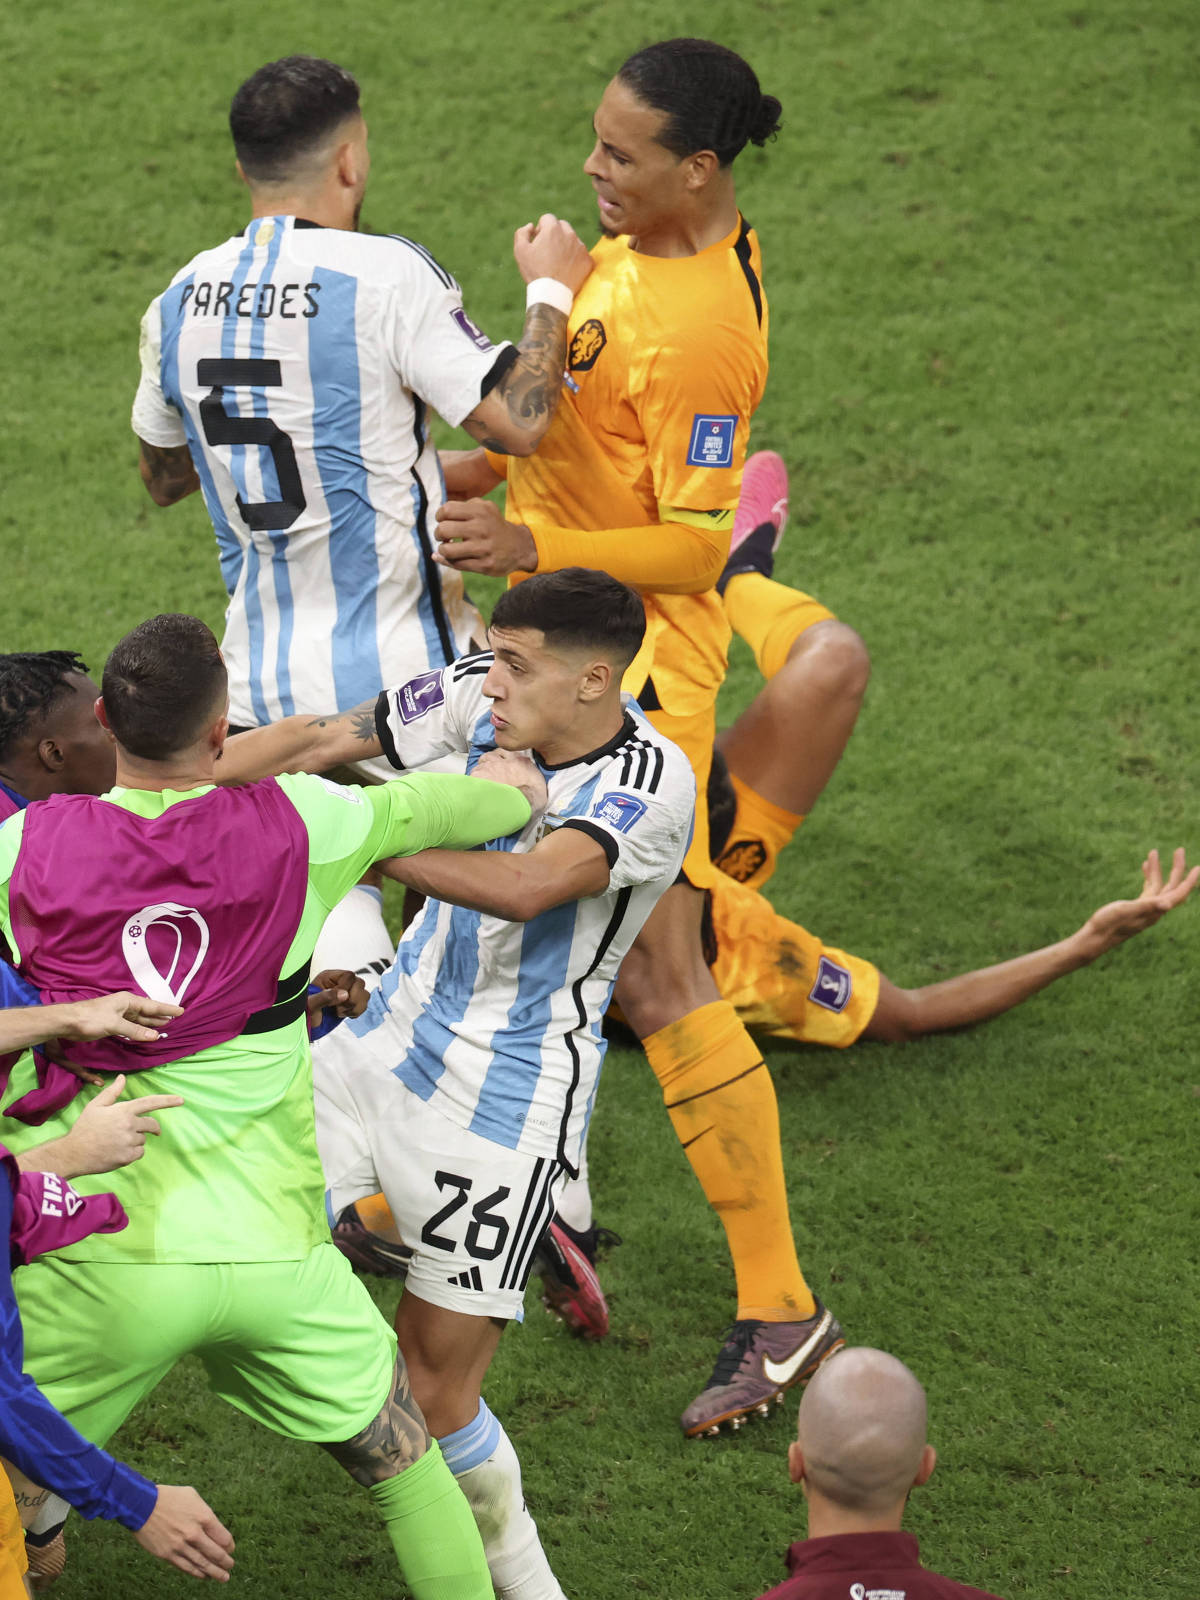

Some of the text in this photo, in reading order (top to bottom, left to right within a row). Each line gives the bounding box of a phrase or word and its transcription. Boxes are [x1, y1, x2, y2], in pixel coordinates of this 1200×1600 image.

[178, 282, 321, 319] PAREDES
[197, 358, 307, 531] 5
[421, 1169, 511, 1261] 26
